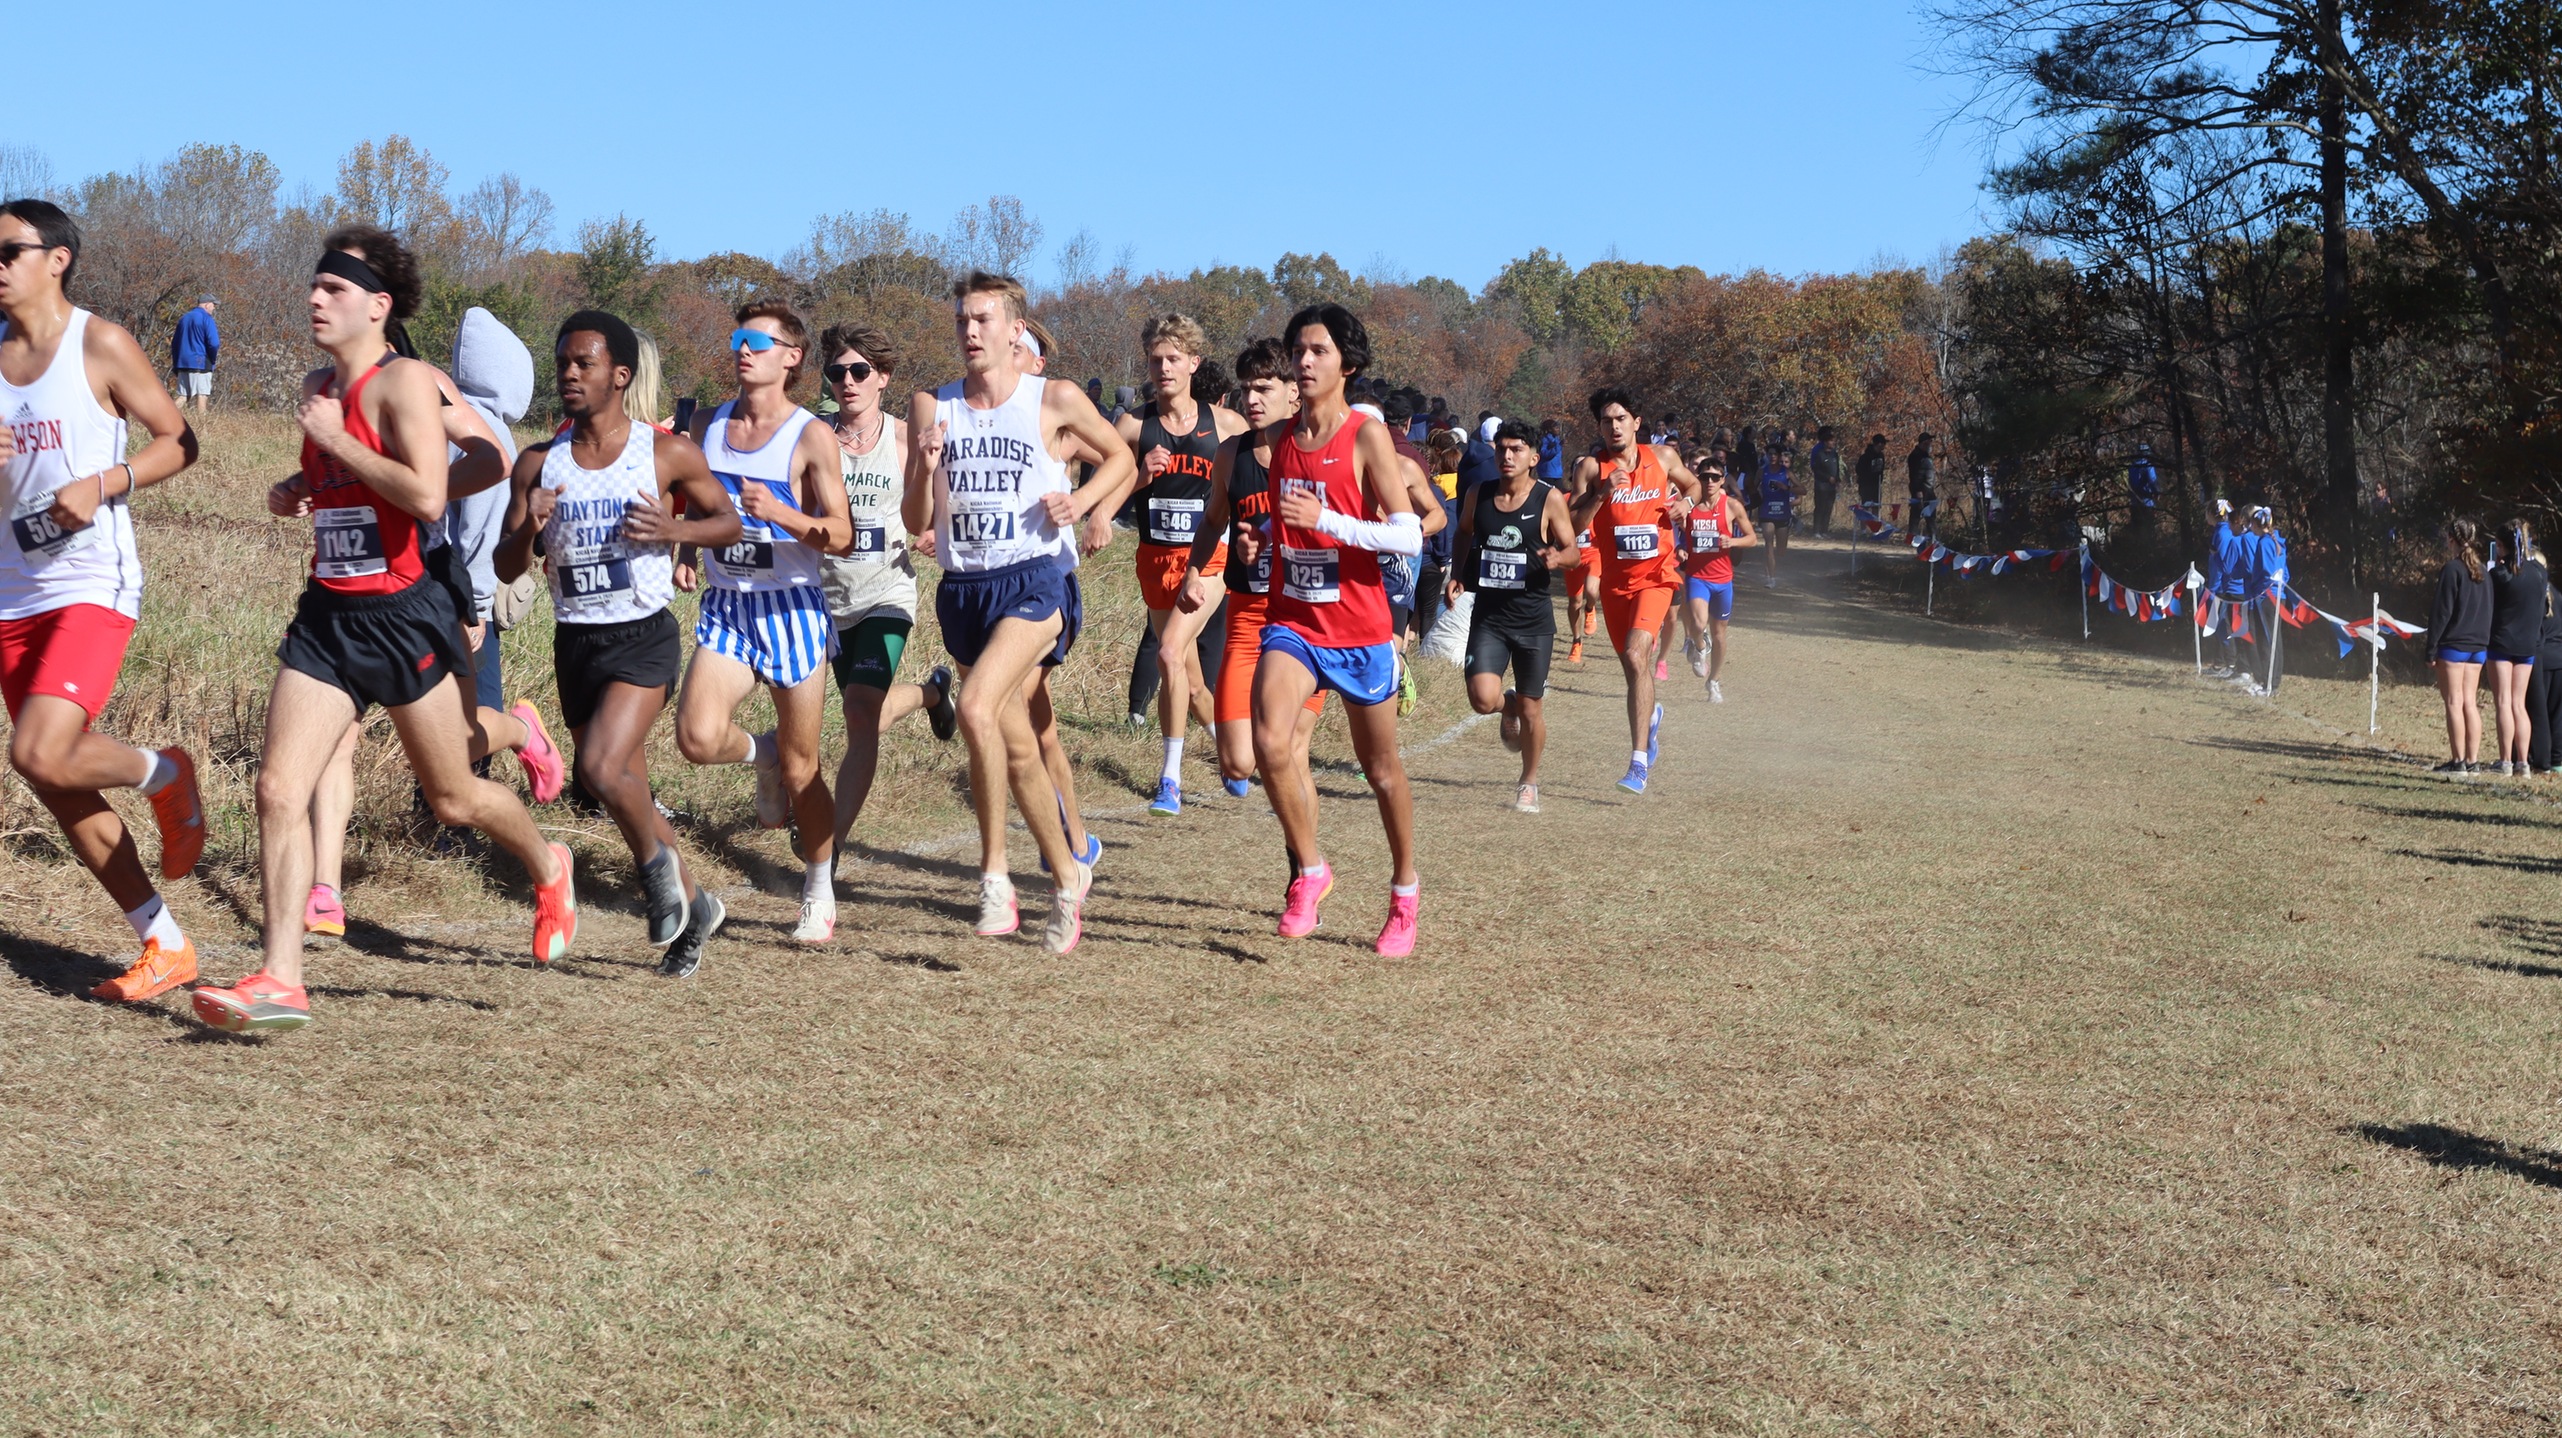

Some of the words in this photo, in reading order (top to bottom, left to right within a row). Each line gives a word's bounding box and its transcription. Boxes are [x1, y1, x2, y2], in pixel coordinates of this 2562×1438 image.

[11, 419, 63, 454] WSON
[941, 436, 1034, 468] PARADISE
[1154, 453, 1214, 480] WLEY
[841, 472, 891, 490] MARCK
[947, 470, 1023, 492] VALLEY
[848, 493, 877, 507] ATE
[1238, 491, 1271, 519] COW
[1611, 484, 1661, 505] Wallace
[25, 511, 62, 544] 56
[955, 512, 1010, 541] 1427
[1161, 511, 1192, 531] 546
[1693, 519, 1717, 530] MESA
[323, 528, 368, 558] 1142
[1623, 534, 1652, 551] 1113
[1697, 537, 1713, 547] 824
[572, 564, 612, 593] 574
[1291, 564, 1325, 588] 825
[1489, 562, 1516, 580] 934
